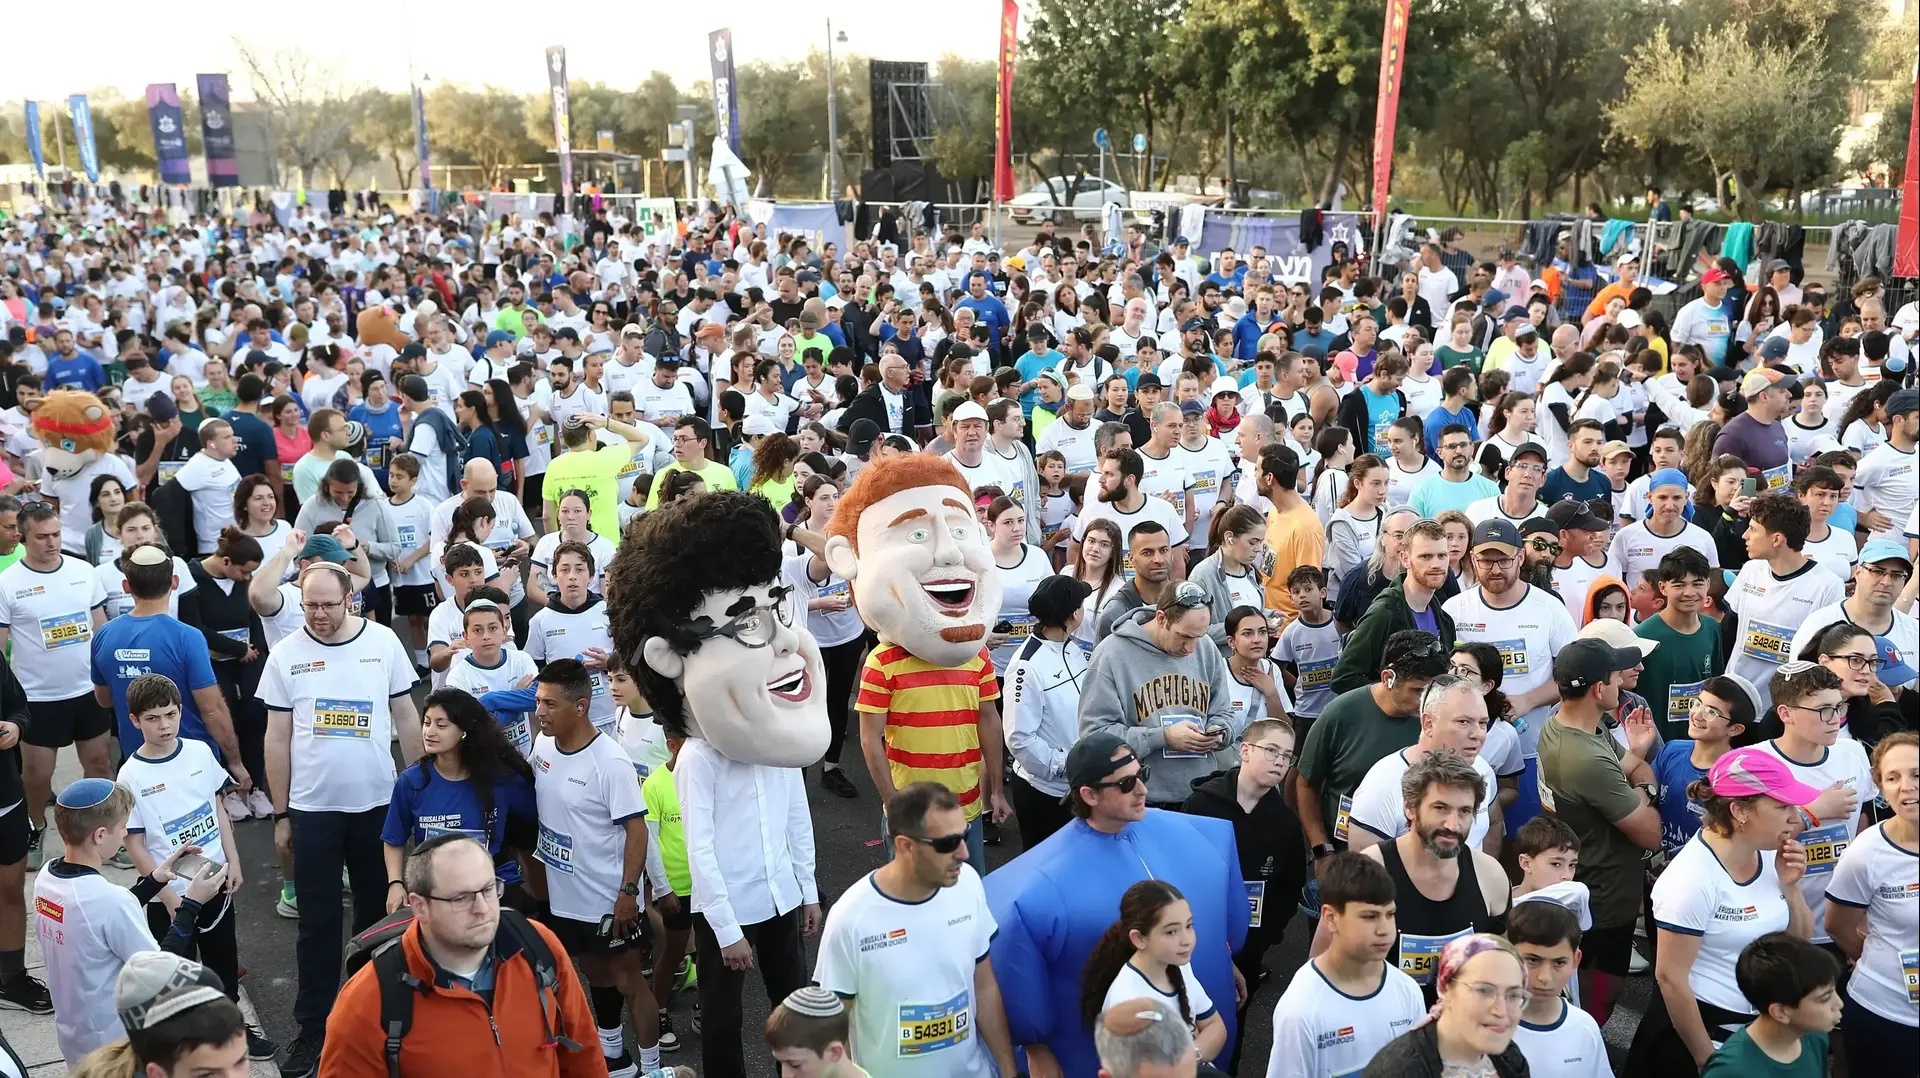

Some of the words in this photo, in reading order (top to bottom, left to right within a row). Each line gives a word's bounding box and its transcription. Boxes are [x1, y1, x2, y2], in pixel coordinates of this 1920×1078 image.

[423, 592, 436, 608] 13
[52, 626, 78, 639] 53126
[1753, 636, 1780, 650] 54246
[122, 650, 148, 659] Winner
[1133, 674, 1209, 723] MICHIGAN
[324, 714, 355, 726] 51690
[419, 815, 446, 823] JERUSALEM
[1339, 816, 1345, 824] A
[171, 838, 178, 846] B
[179, 822, 206, 844] 55471
[41, 901, 62, 918] Winner
[1718, 905, 1743, 914] ERUSALEM
[948, 915, 972, 926] saucony
[1744, 913, 1759, 921] 2025
[859, 932, 887, 947] JERUSALEM
[860, 941, 888, 952] MARATHON
[888, 937, 908, 947] 2025
[1403, 960, 1411, 968] A
[1909, 975, 1917, 984] B
[1389, 1017, 1412, 1028] saucony
[903, 1029, 910, 1039] B
[914, 1020, 953, 1040] 54331
[1336, 1035, 1354, 1045] 2025
